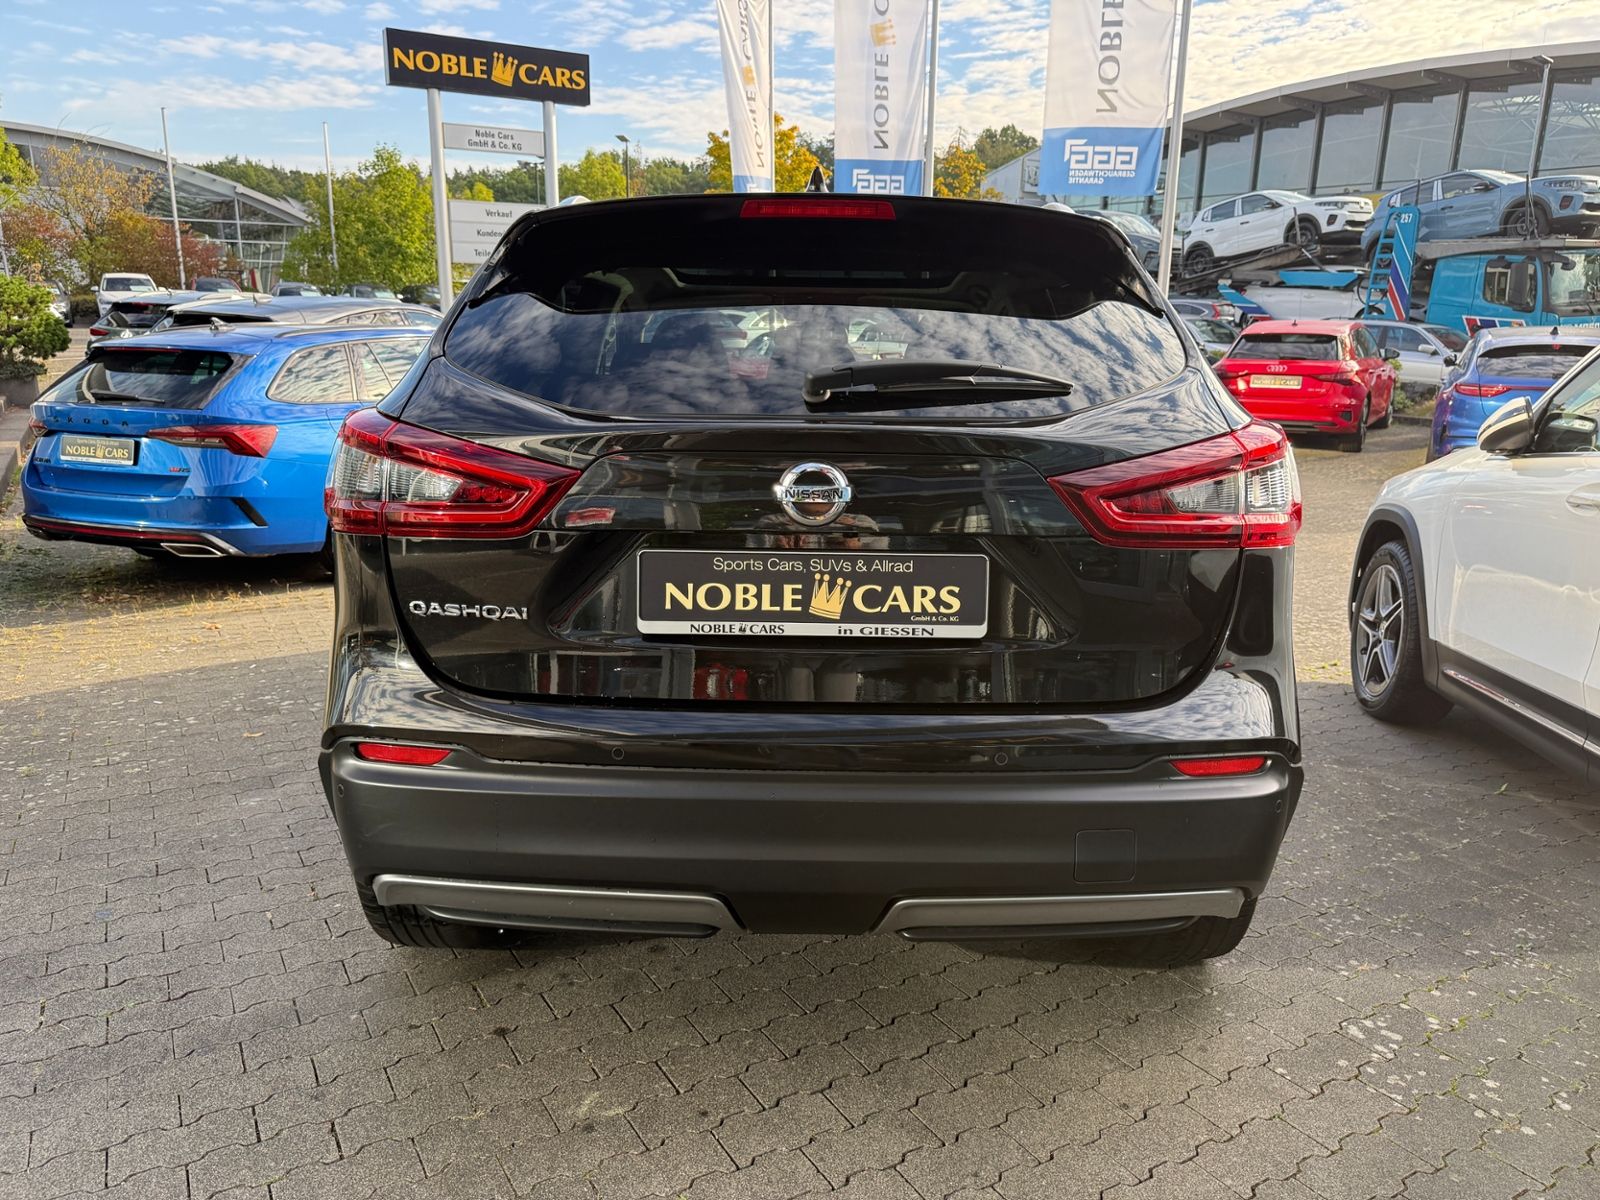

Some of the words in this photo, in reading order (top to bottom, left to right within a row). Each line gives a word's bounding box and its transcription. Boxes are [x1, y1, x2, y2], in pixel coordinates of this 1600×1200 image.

[393, 47, 488, 79] NOBLE
[518, 63, 586, 91] CARS
[475, 129, 495, 138] Noble
[497, 131, 514, 140] Cars
[468, 138, 489, 148] GmbH
[490, 140, 497, 149] &
[498, 141, 510, 150] Co.
[511, 142, 523, 151] KG
[485, 208, 513, 218] Verkauf
[1400, 213, 1413, 223] 257
[474, 248, 491, 257] Teile
[65, 444, 96, 457] NOBLE
[104, 447, 129, 458] CARS
[784, 487, 844, 500] NISSAN
[713, 557, 764, 573] Sports
[767, 558, 807, 573] Cars,
[809, 558, 852, 573] SUVs
[855, 560, 867, 572] &
[870, 560, 914, 573] Allrad
[664, 582, 802, 611] NOBLE
[852, 584, 961, 614] CARS
[408, 600, 528, 621] QASHQAI
[690, 623, 736, 634] NOBLE
[749, 624, 785, 635] CARS
[838, 625, 853, 635] in
[859, 626, 934, 636] GIESSEN
